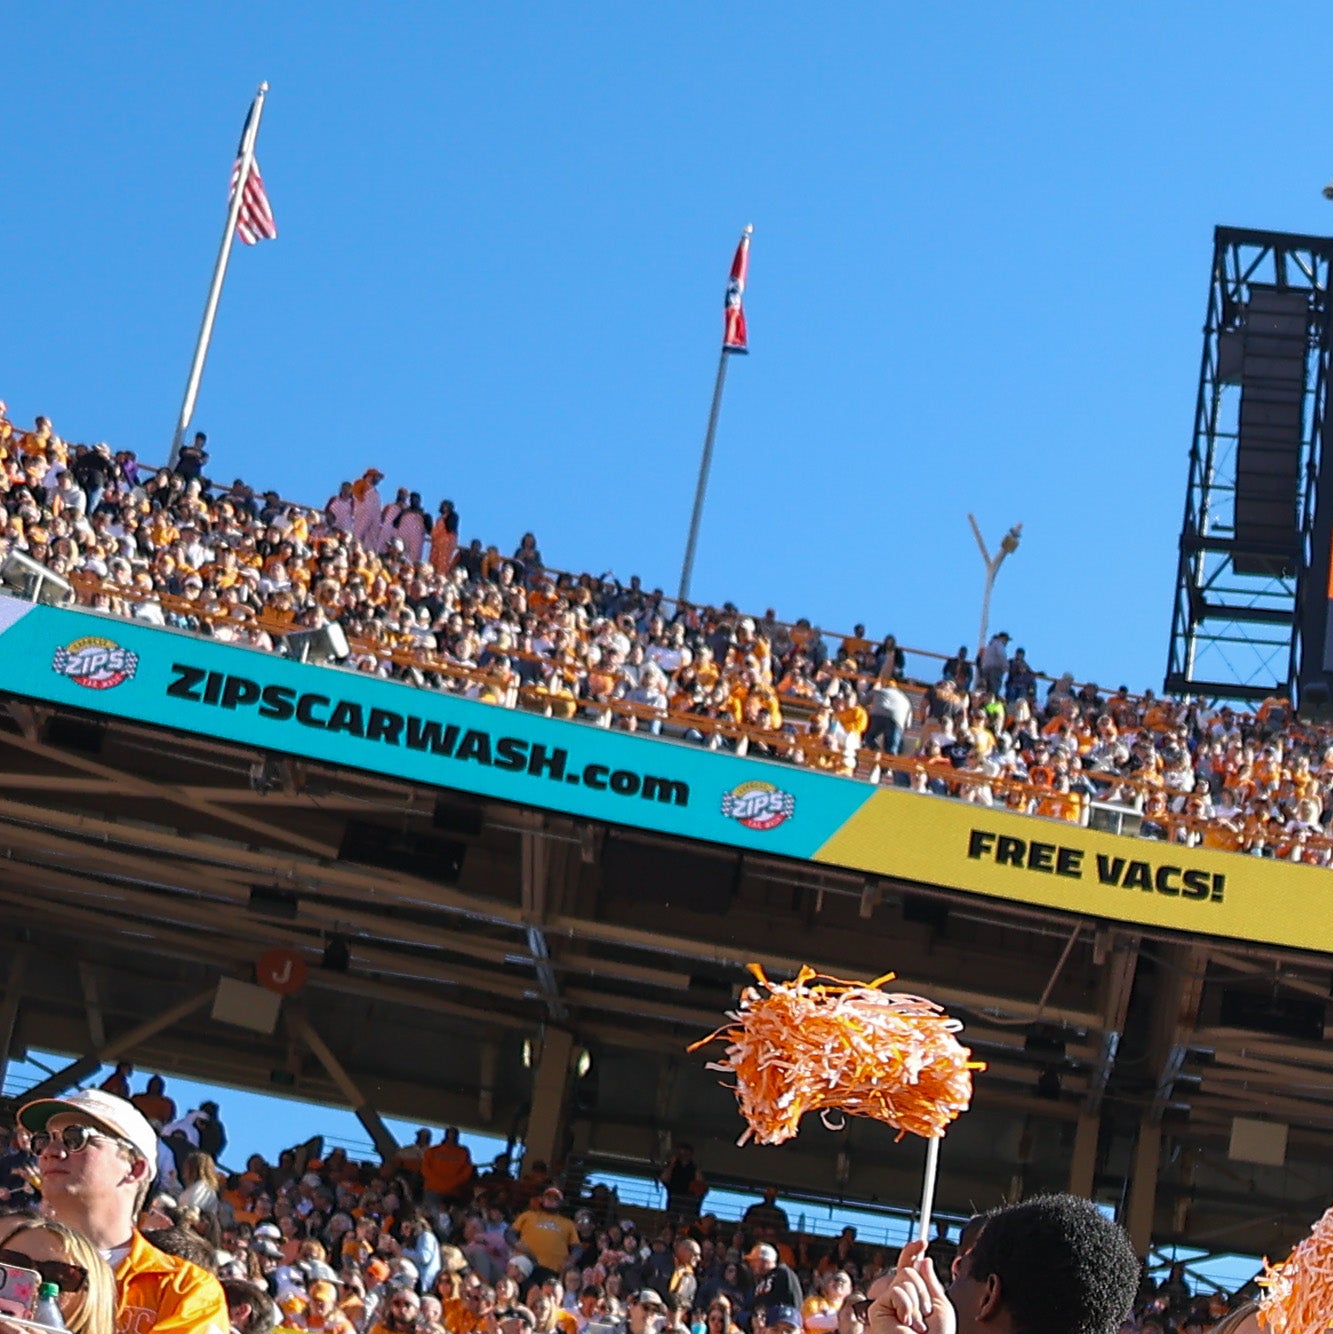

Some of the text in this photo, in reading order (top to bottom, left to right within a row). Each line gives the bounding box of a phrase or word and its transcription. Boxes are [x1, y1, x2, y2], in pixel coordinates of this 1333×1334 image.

[65, 650, 125, 674] ZIPS
[165, 663, 690, 807] ZIPSCARWASH.com
[732, 792, 784, 818] ZIPS
[967, 828, 1226, 903] FREE VACS!
[271, 959, 293, 984] J
